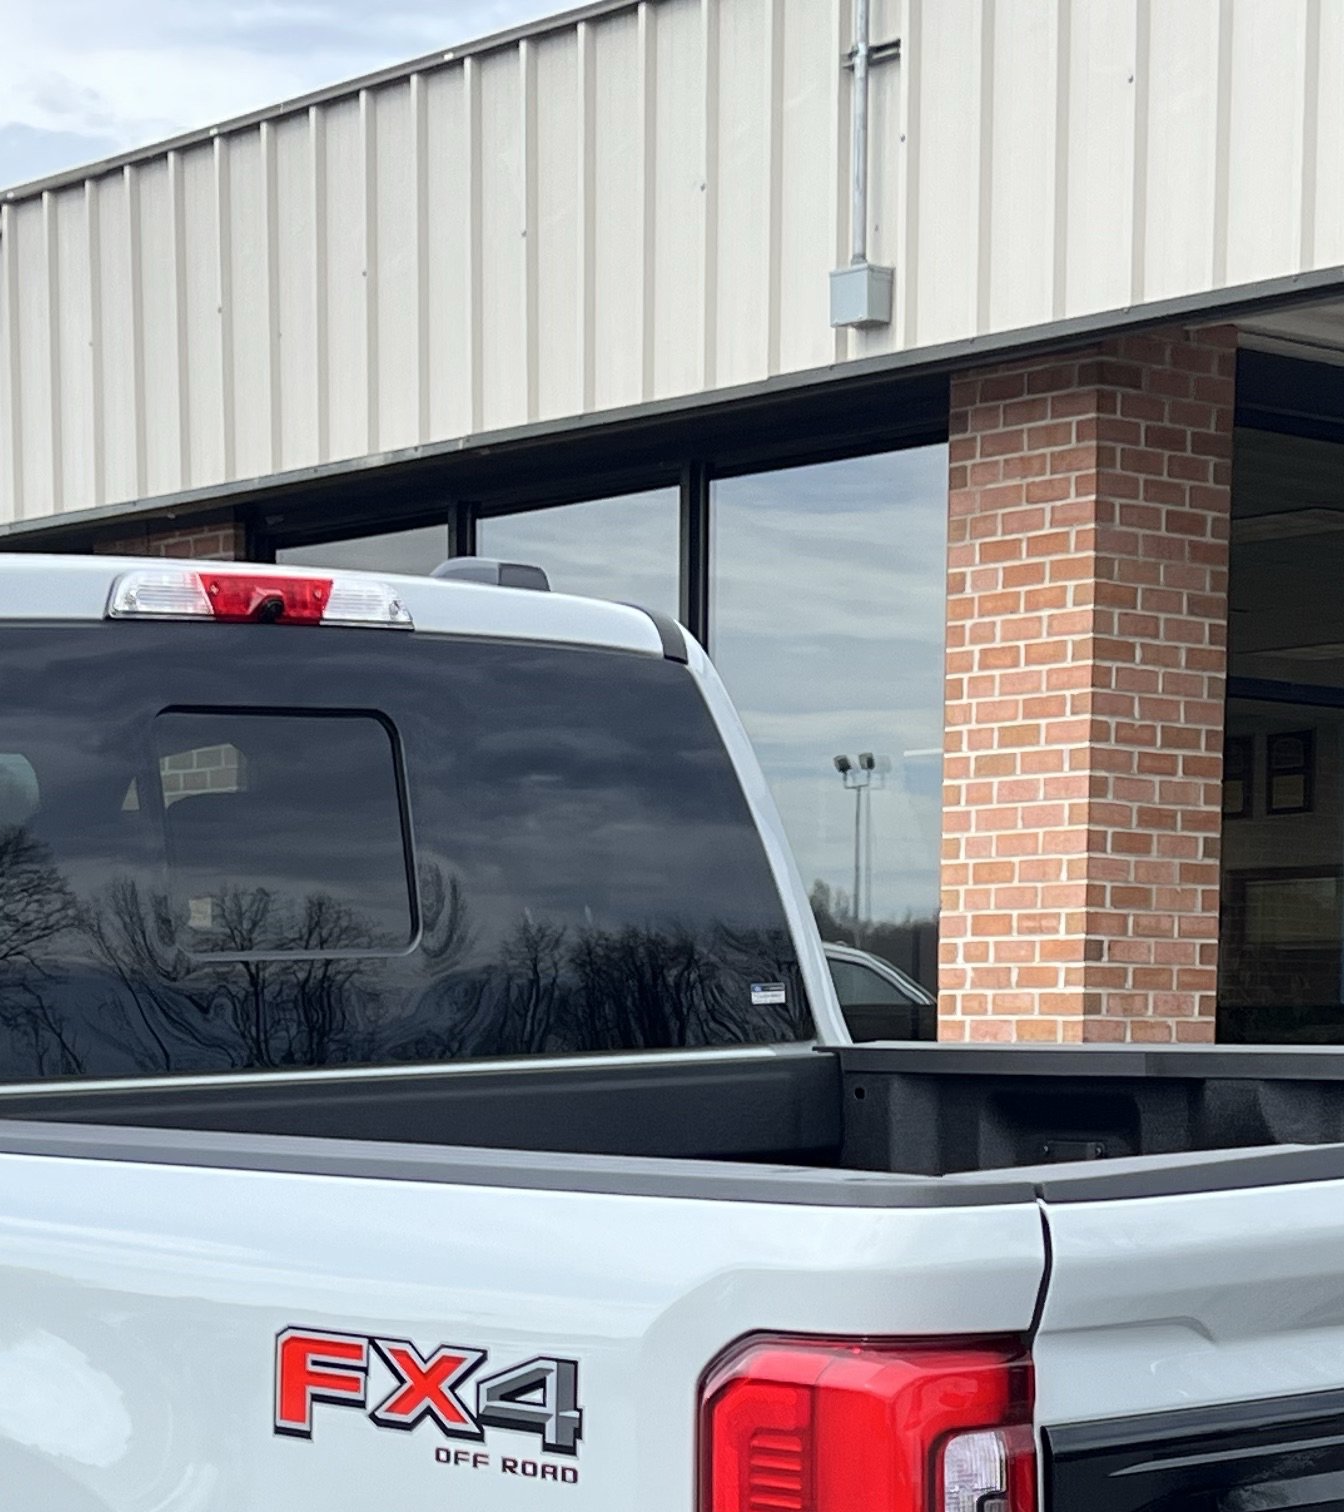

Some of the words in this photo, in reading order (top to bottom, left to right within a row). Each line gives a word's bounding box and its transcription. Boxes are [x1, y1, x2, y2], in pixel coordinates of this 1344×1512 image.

[273, 1325, 583, 1456] FX4
[434, 1446, 490, 1470] OFF
[501, 1456, 580, 1485] ROAD
